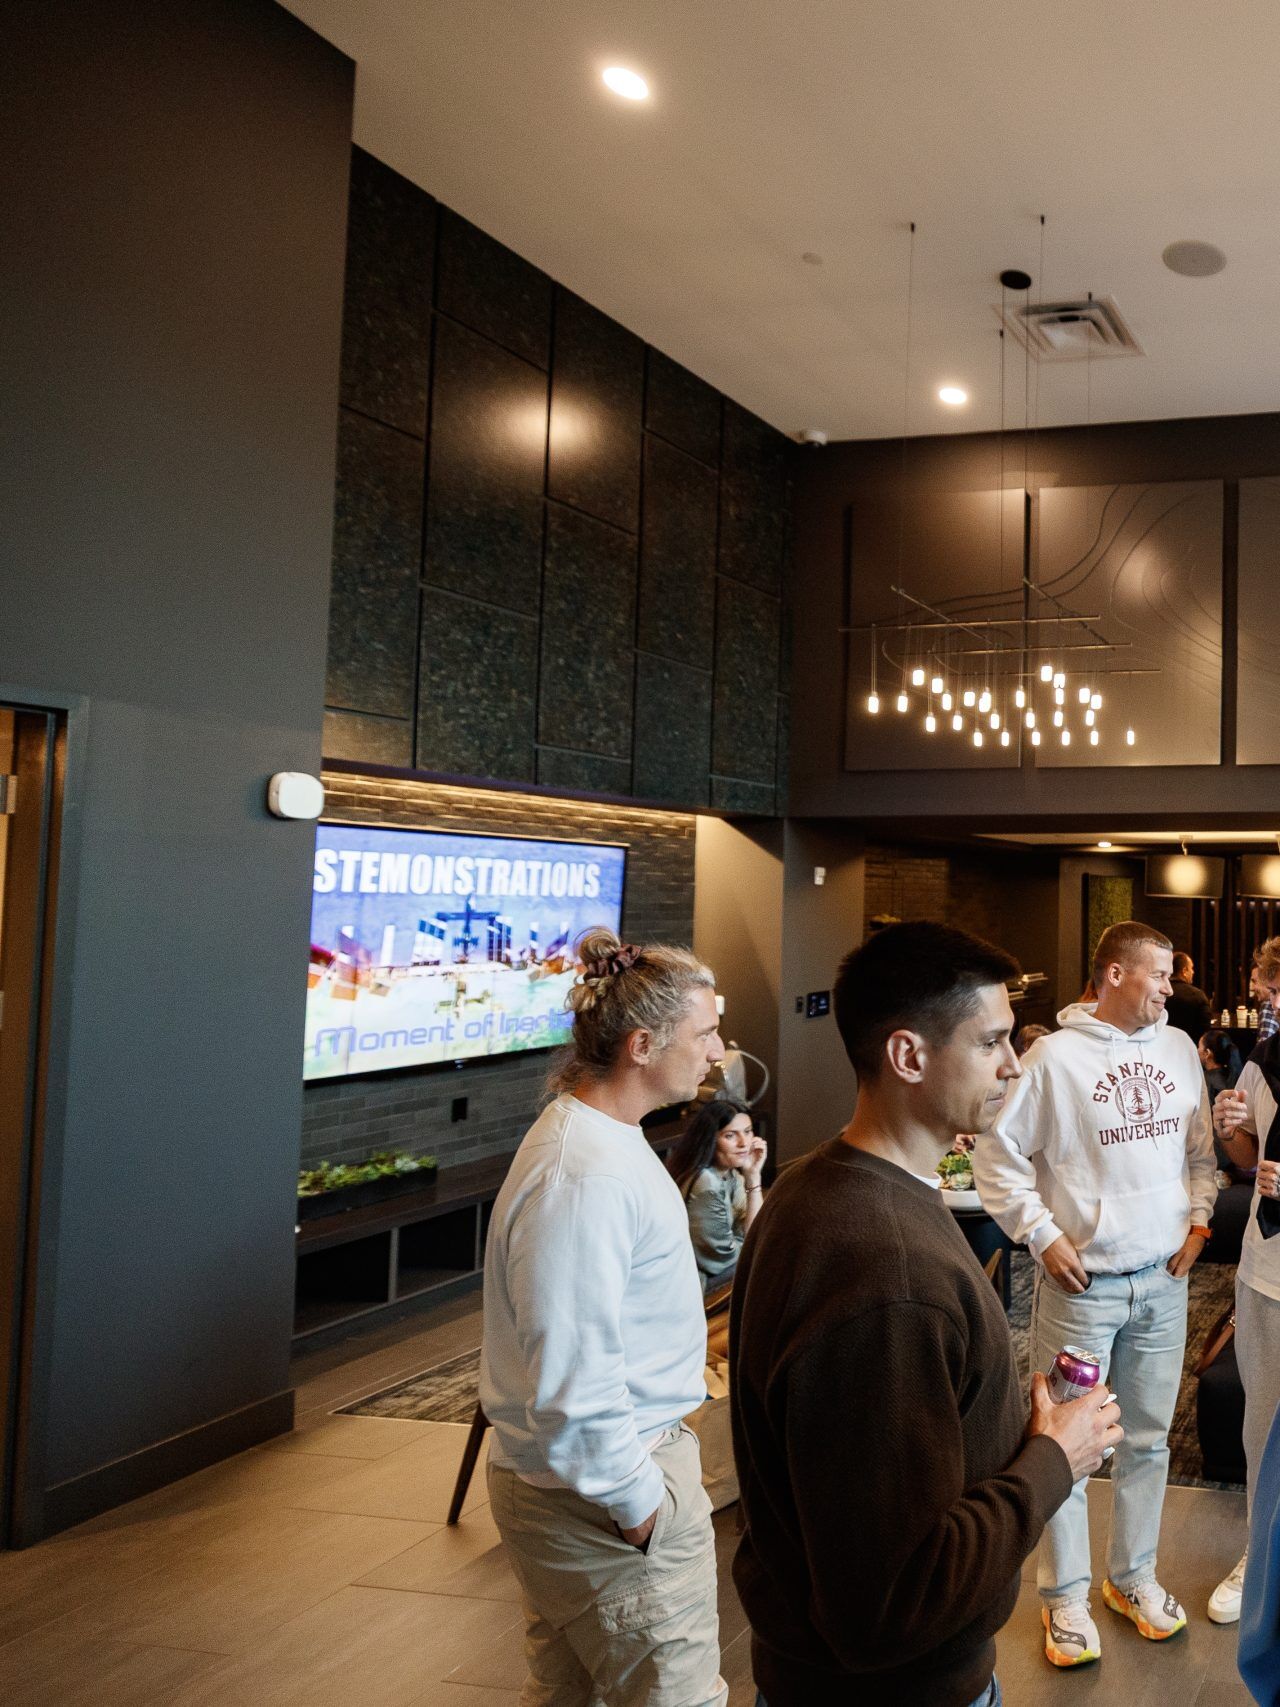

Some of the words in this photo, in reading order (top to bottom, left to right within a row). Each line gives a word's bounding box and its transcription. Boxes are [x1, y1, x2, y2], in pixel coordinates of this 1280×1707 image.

[313, 849, 600, 898] STEMONSTRATIONS
[314, 1017, 455, 1056] Moment
[464, 1012, 494, 1039] of
[1093, 1062, 1176, 1104] STANFORD
[1099, 1117, 1180, 1146] UNIVERSITY
